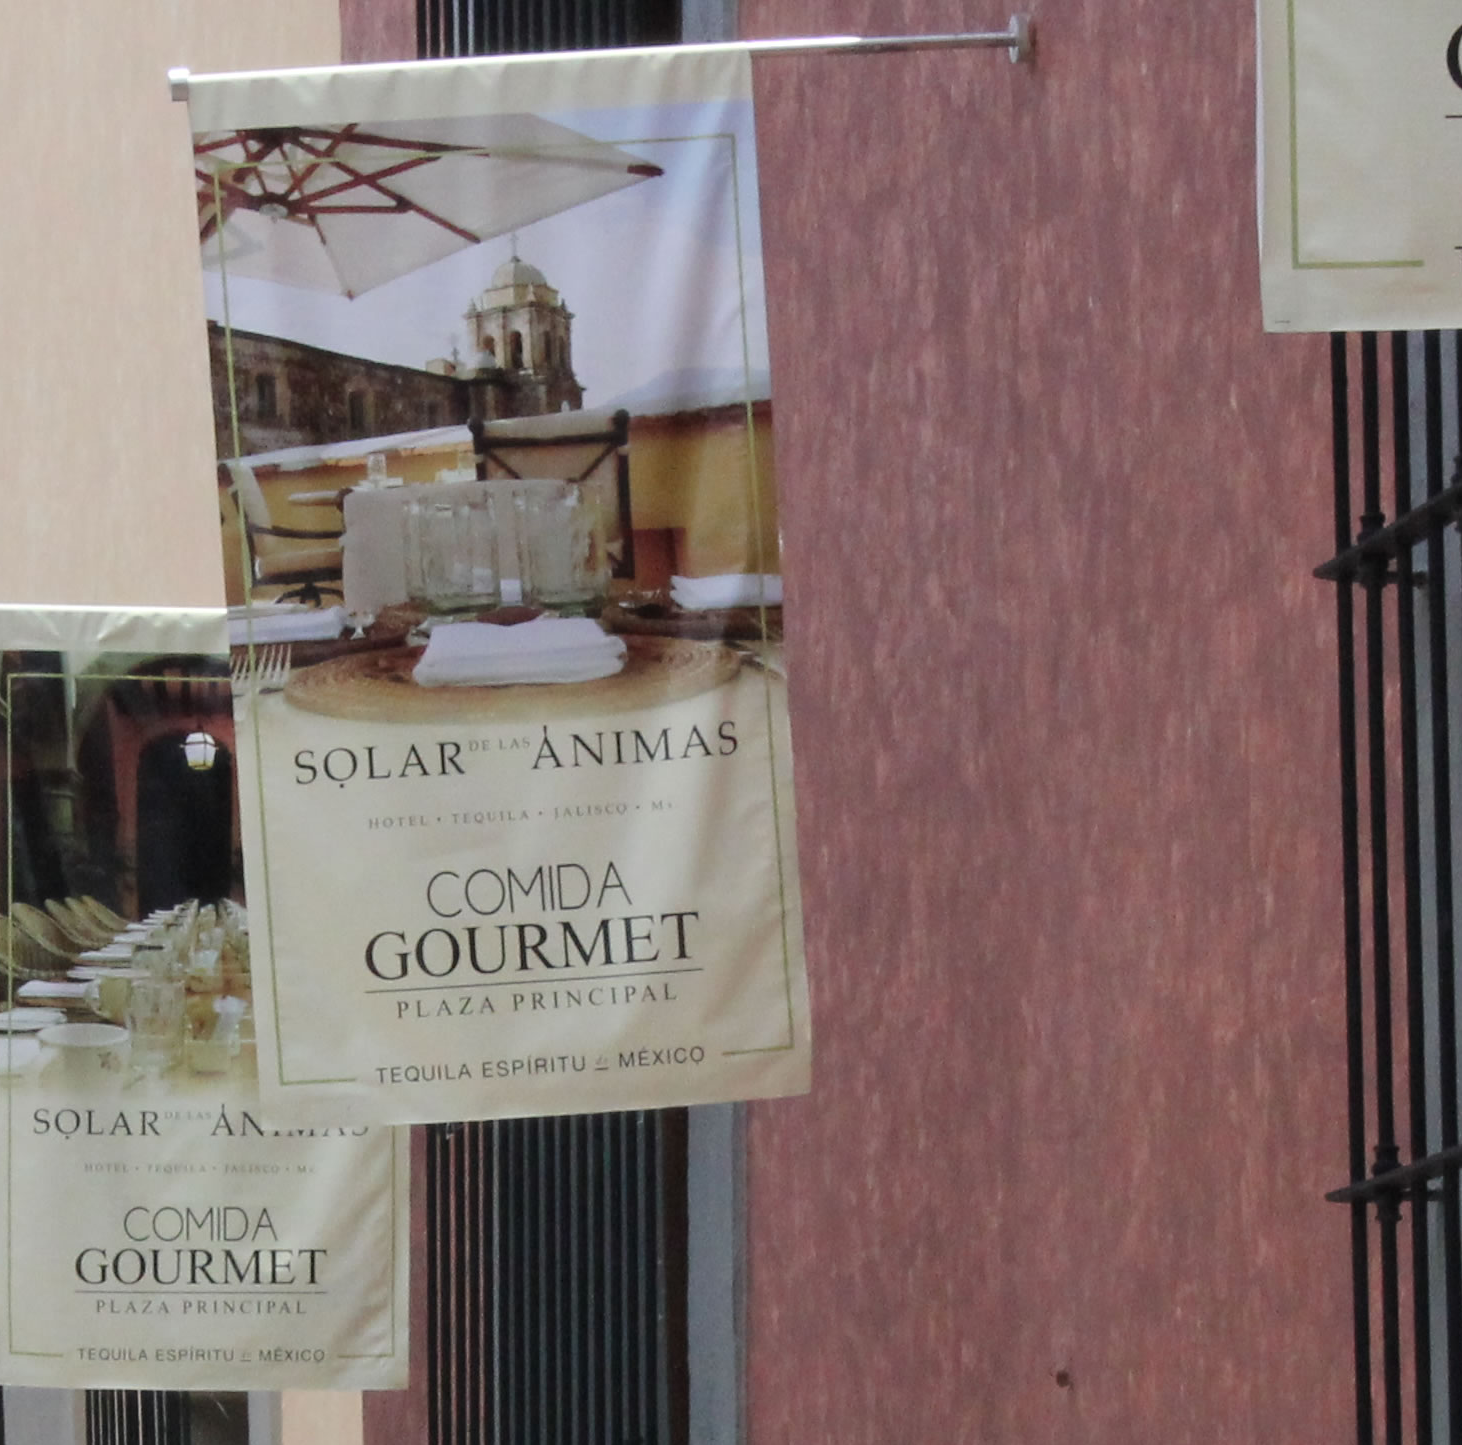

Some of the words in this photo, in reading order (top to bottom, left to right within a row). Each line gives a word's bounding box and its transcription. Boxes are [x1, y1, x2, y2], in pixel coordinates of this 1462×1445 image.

[294, 741, 466, 788] SOLAR
[468, 739, 493, 752] DE
[499, 736, 531, 751] LAS
[368, 815, 429, 830] HOTEL
[452, 809, 530, 826] TEQUILA
[552, 802, 628, 820] JALISCO
[427, 861, 632, 918] COMIDA
[364, 911, 699, 981] GOURMET
[397, 996, 496, 1019] PLAZA
[512, 983, 678, 1013] PRINCIPAL
[376, 1062, 472, 1085] TEQUILA
[482, 1053, 586, 1079] ESPÍRITU
[619, 1046, 705, 1068] MÉXICO
[33, 1108, 161, 1139] SOLAR
[124, 1206, 278, 1242] COMIDA
[75, 1248, 328, 1286] GOURMET
[96, 1300, 170, 1315] PLAZA
[183, 1300, 307, 1315] PRINCIPAL
[78, 1348, 148, 1363] TEQUILA
[155, 1345, 235, 1363] ESPÍRITU
